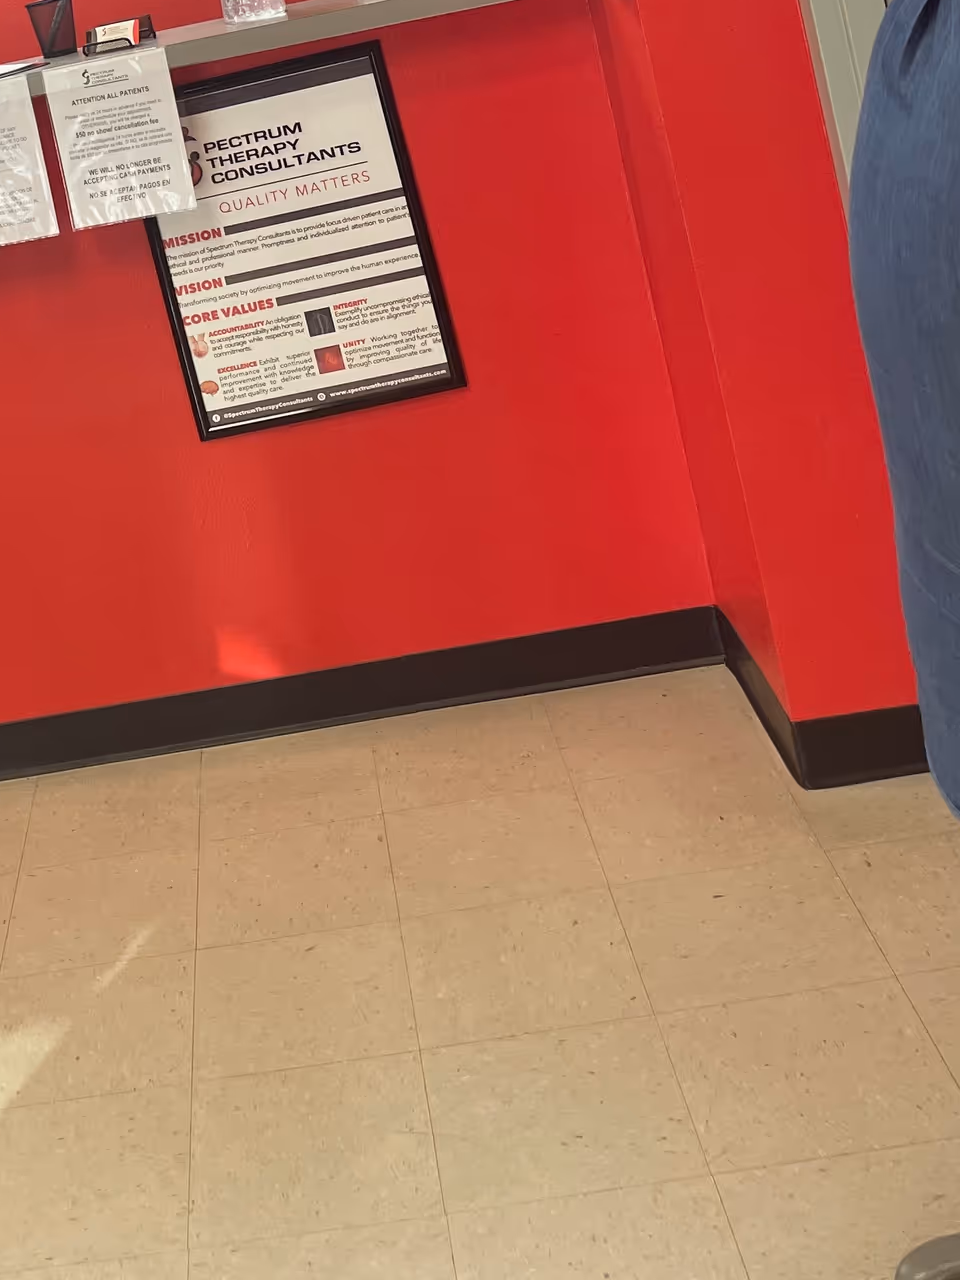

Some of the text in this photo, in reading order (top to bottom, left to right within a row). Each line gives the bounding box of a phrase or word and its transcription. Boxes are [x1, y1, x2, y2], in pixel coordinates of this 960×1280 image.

[72, 95, 105, 106] ATTENTION
[120, 86, 149, 96] PATIENTS
[114, 121, 149, 131] cancellation
[203, 122, 302, 154] PECTRUM
[126, 159, 152, 169] LONGER
[206, 139, 299, 168] THERAPY
[211, 142, 361, 184] CONSULTANTS
[137, 164, 171, 175] PAYMENTS
[139, 181, 160, 190] PAGOS
[219, 171, 370, 213] QUALITY MATTERS
[163, 228, 221, 248] MISSION
[178, 251, 199, 259] mission
[206, 243, 234, 253] Spectrum
[233, 239, 257, 247] Therapy
[258, 231, 292, 241] Consultants
[303, 223, 325, 233] provide
[361, 210, 381, 220] patient
[202, 250, 235, 263] professional
[261, 238, 295, 248] Promptness
[310, 225, 349, 238] individualized
[351, 221, 376, 230] attention
[174, 278, 223, 296] VISION
[218, 292, 239, 300] society
[249, 283, 281, 293] optimizing
[282, 275, 315, 286] movement
[324, 269, 349, 277] improve
[361, 261, 383, 269] human
[182, 298, 274, 328] CORE VALUES
[333, 298, 367, 310] INTEGRITY
[335, 307, 364, 317] Exemplify
[363, 297, 412, 314] uncompromising
[337, 313, 360, 323] conduct
[360, 312, 368, 320] to
[390, 305, 400, 314] the
[401, 302, 419, 310] things
[209, 321, 266, 337] ACCOUNTABILITY
[274, 314, 301, 325] obligation
[281, 321, 303, 329] honesty
[225, 341, 247, 350] courage
[265, 331, 293, 340] respecting
[343, 339, 365, 348] UNITY
[370, 334, 397, 342] Working
[401, 327, 427, 336] together
[345, 346, 371, 356] optimize
[372, 339, 404, 349] movement
[405, 335, 416, 345] and
[217, 351, 311, 374] EXCELLENCE Exhibit superior
[346, 355, 354, 364] by
[359, 350, 390, 360] improving
[395, 344, 415, 353] quality
[348, 359, 372, 369] through
[373, 351, 418, 364] compassionate
[219, 357, 312, 383] performance and continued
[220, 375, 262, 388] improvement
[279, 365, 314, 375] knowledge
[223, 387, 234, 397] and
[239, 382, 266, 391] expertise
[281, 375, 301, 383] deliver
[330, 370, 446, 396] www.spectrumtherapyconsultants.com
[224, 393, 247, 402] highest
[248, 389, 268, 397] quality
[224, 397, 313, 418] @SpectrumTherapyConsultants
